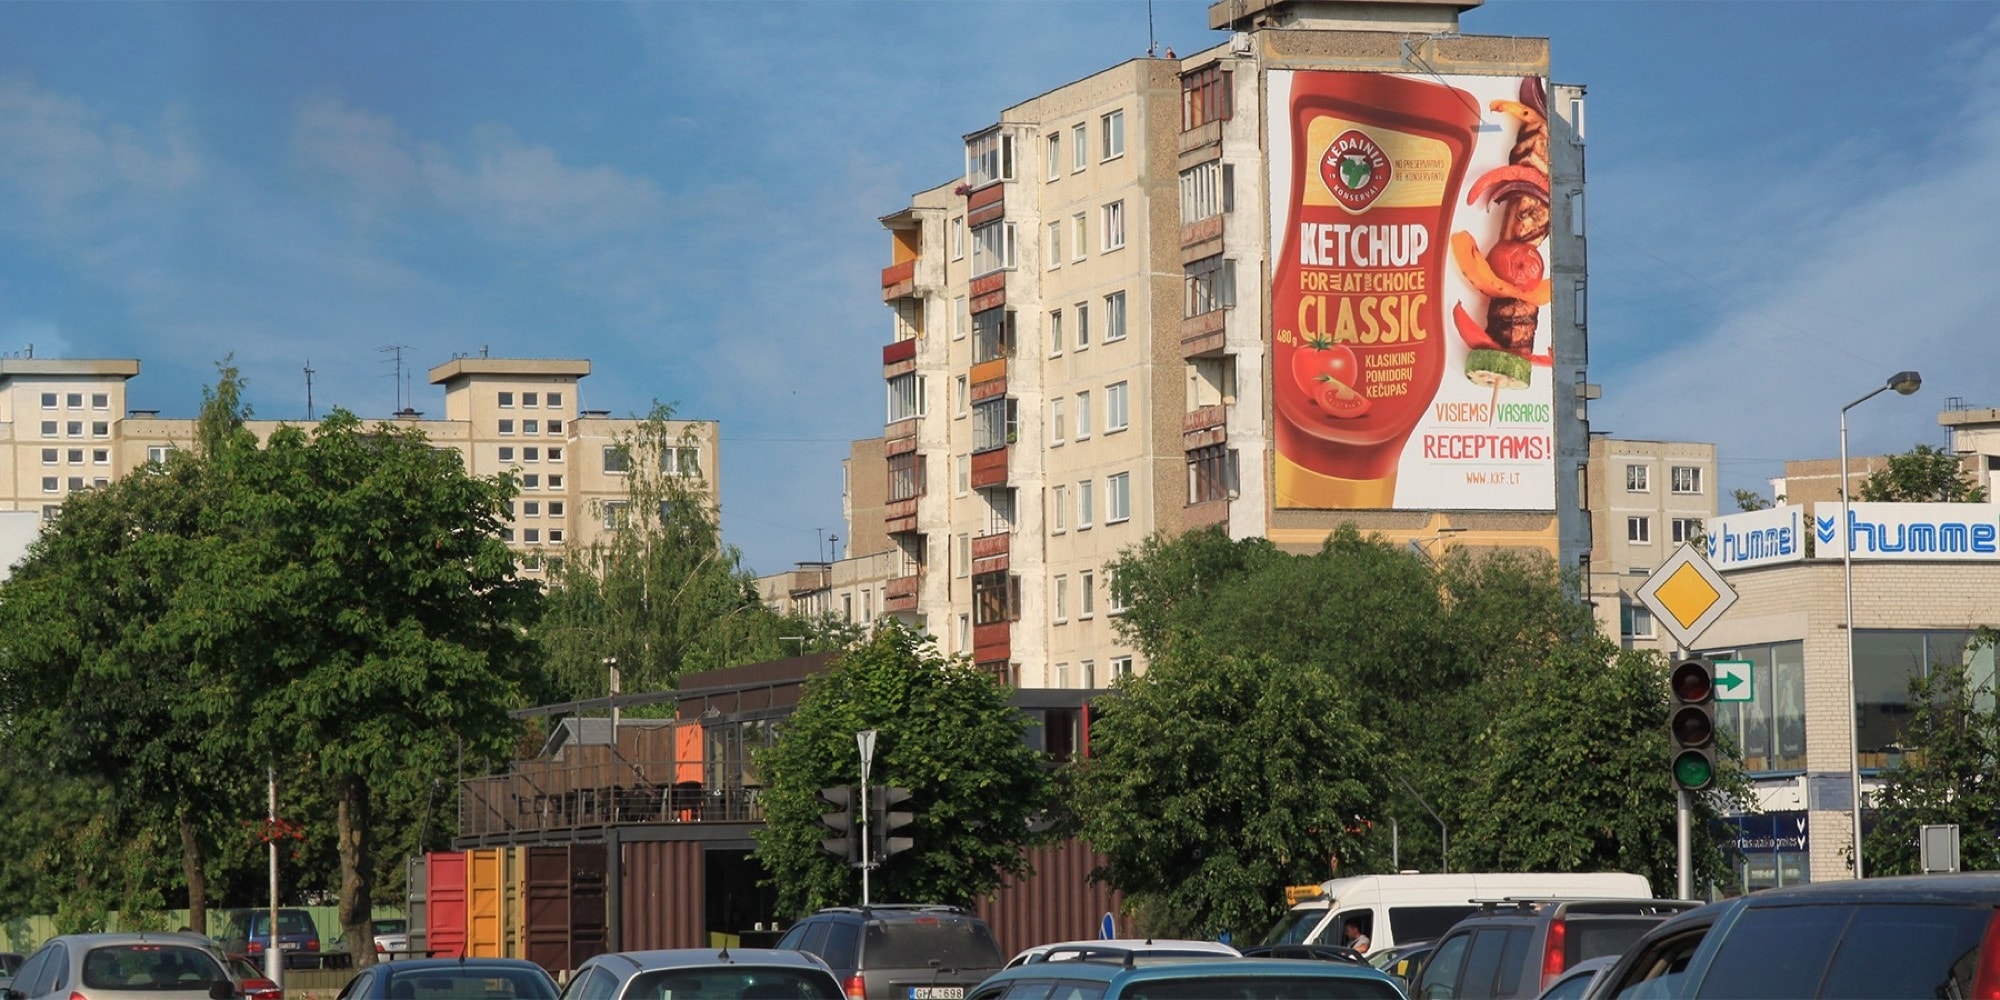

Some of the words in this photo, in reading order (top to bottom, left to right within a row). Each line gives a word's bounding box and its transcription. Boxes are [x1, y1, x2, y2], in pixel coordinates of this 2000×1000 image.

[1333, 184, 1379, 202] KONSERVAI
[1300, 223, 1429, 267] KETCHUP
[1300, 271, 1329, 291] FOR
[1330, 273, 1342, 291] ALL
[1343, 272, 1363, 292] AT
[1373, 271, 1425, 292] CHOICE
[1298, 293, 1428, 344] CLASSIC
[1365, 351, 1416, 368] KLASIKINIS
[1365, 367, 1413, 383] POMIDORŲ
[1366, 382, 1408, 398] KEČUPAS
[1436, 403, 1488, 423] VISIEMS
[1497, 403, 1550, 423] VASAROS
[1423, 434, 1551, 460] RECEPTAMS!
[1466, 472, 1521, 484] WWW.KKF.LT
[1722, 511, 1797, 563] hummel
[1848, 509, 2000, 553] humme
